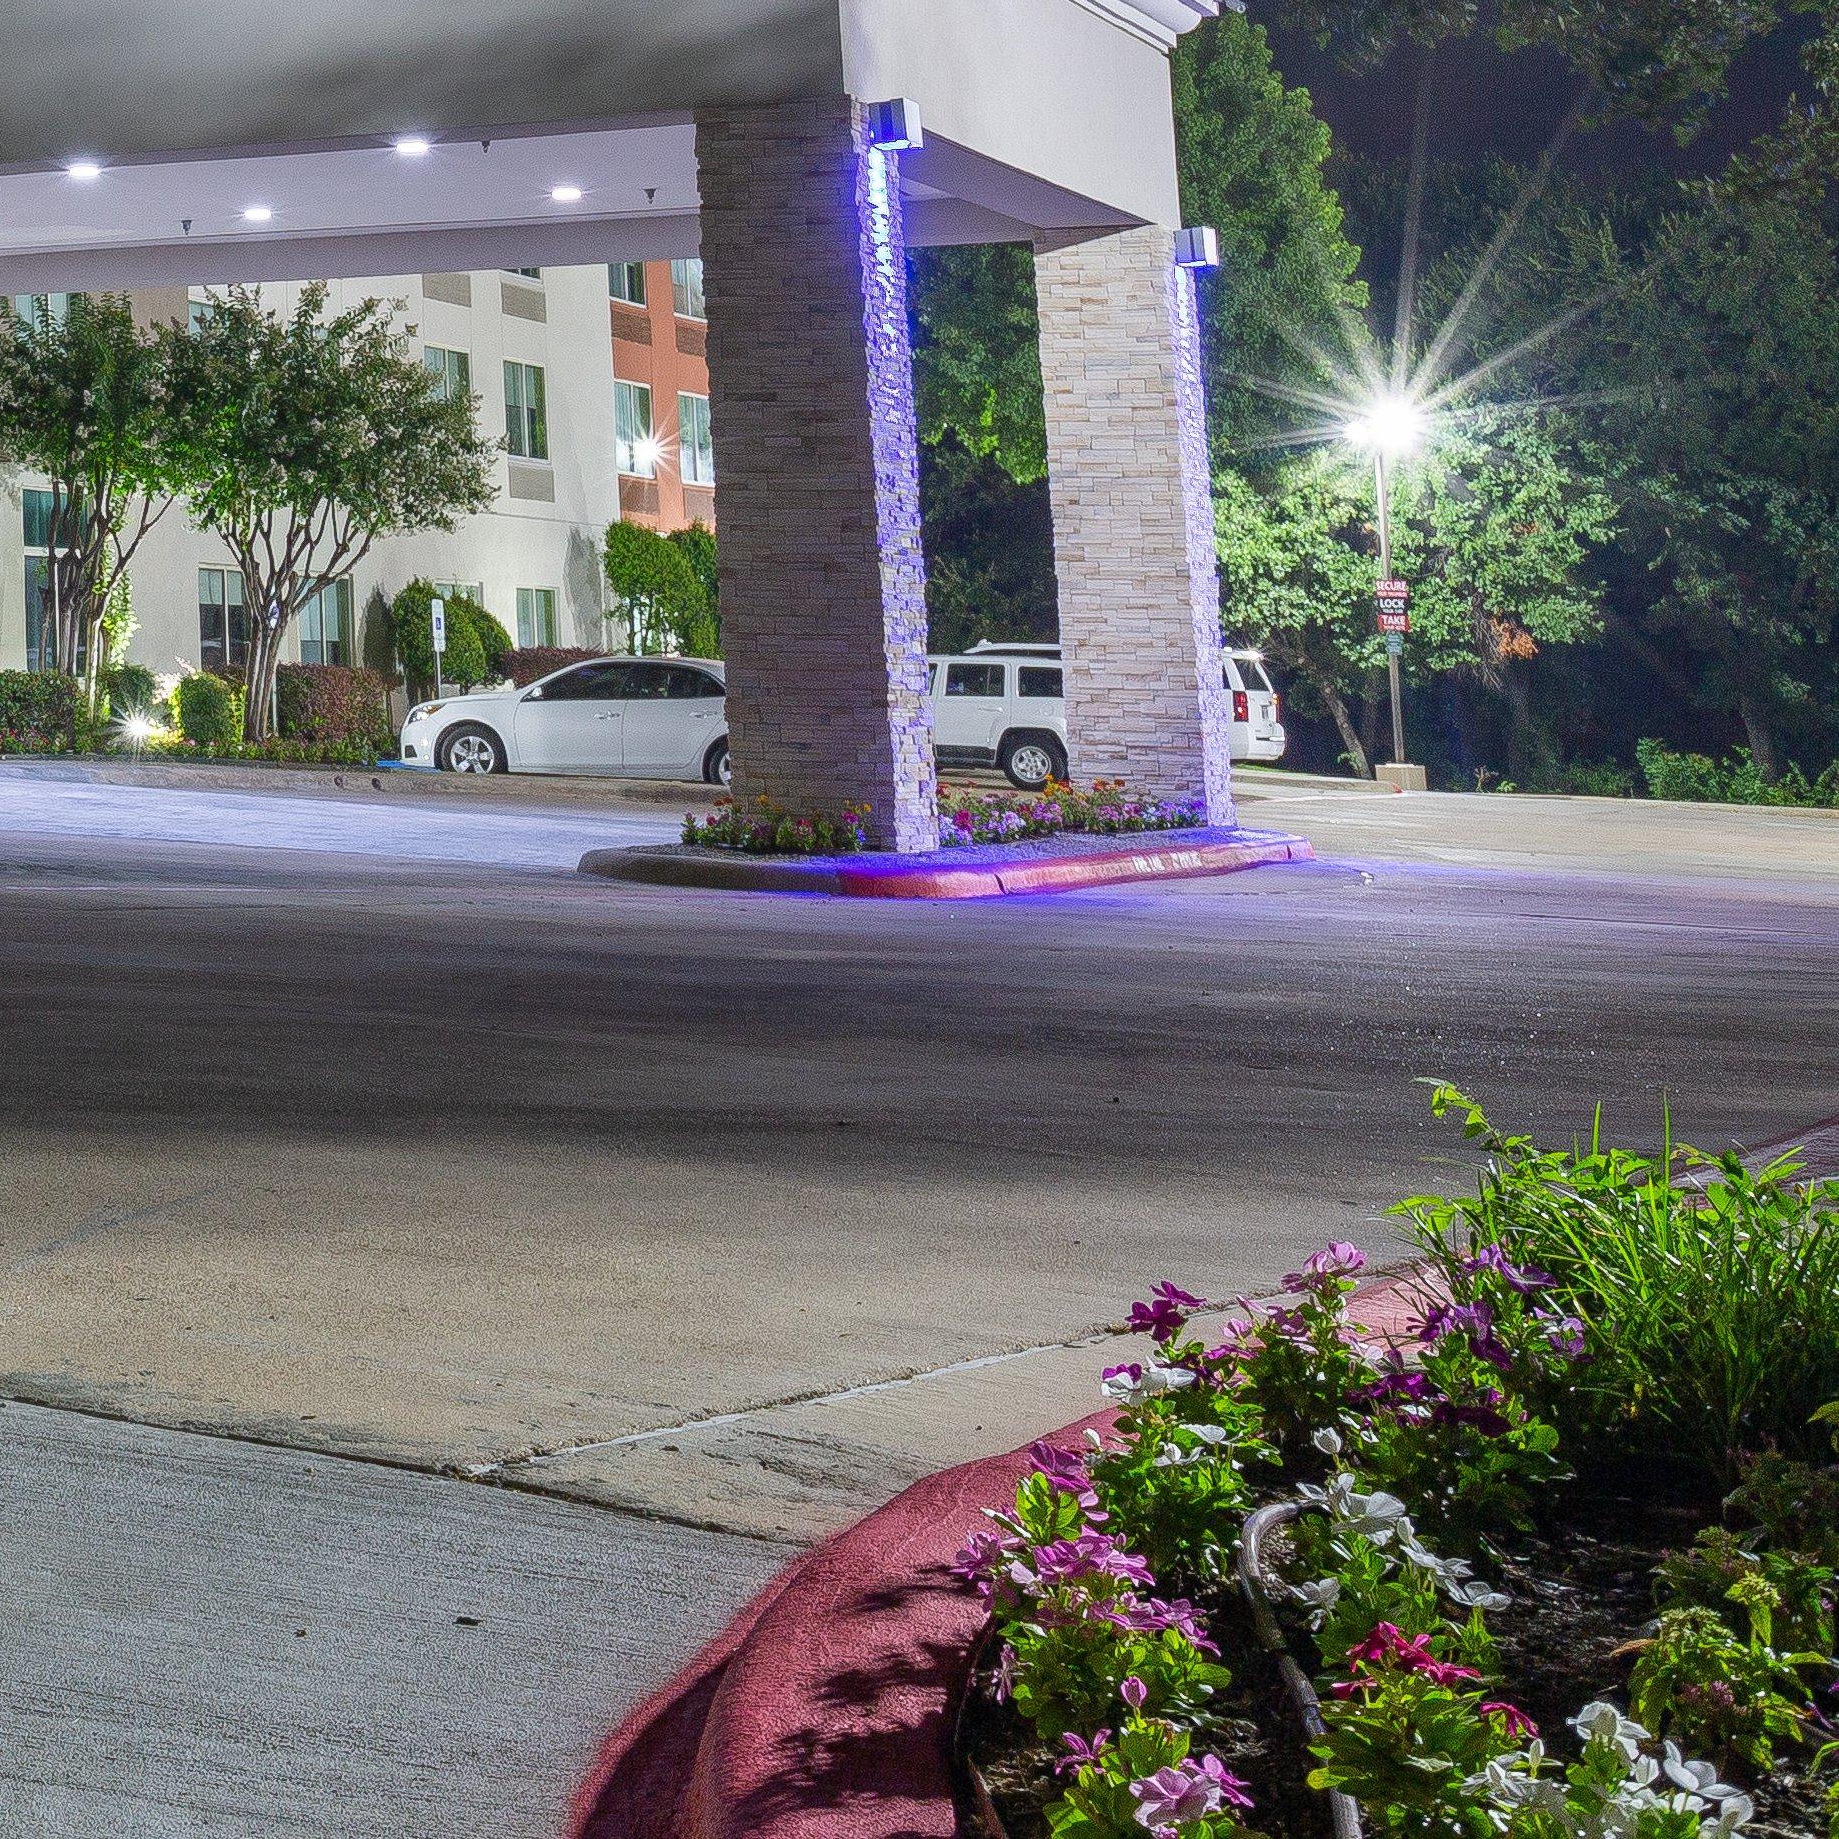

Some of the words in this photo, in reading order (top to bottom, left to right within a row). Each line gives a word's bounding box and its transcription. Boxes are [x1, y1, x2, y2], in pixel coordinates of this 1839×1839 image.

[1376, 580, 1406, 591] SECURE
[1379, 598, 1405, 609] LOCK
[1381, 615, 1405, 626] TAKE
